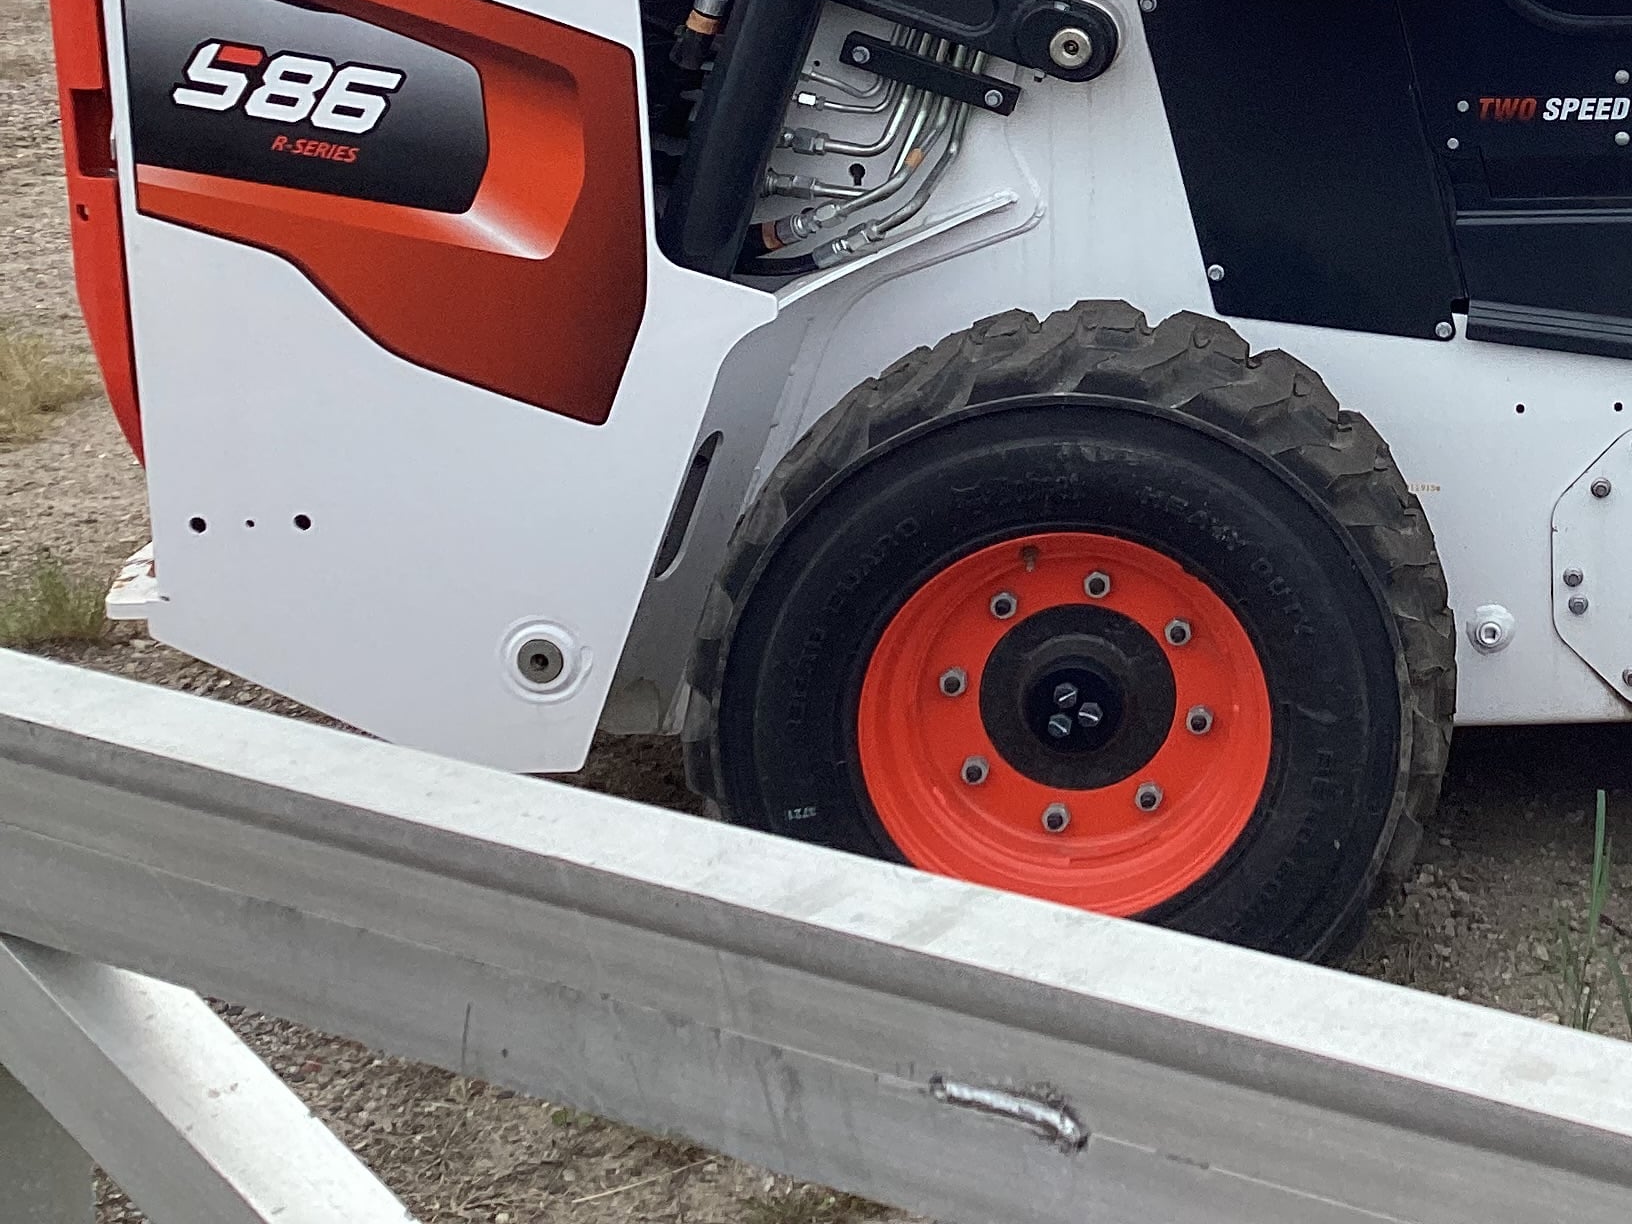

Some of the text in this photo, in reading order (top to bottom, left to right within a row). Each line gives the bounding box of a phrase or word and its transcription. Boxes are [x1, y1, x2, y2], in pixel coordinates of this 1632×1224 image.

[173, 41, 404, 134] S86
[1479, 97, 1631, 122] TWO SPEED
[271, 135, 360, 164] R-SERIES
